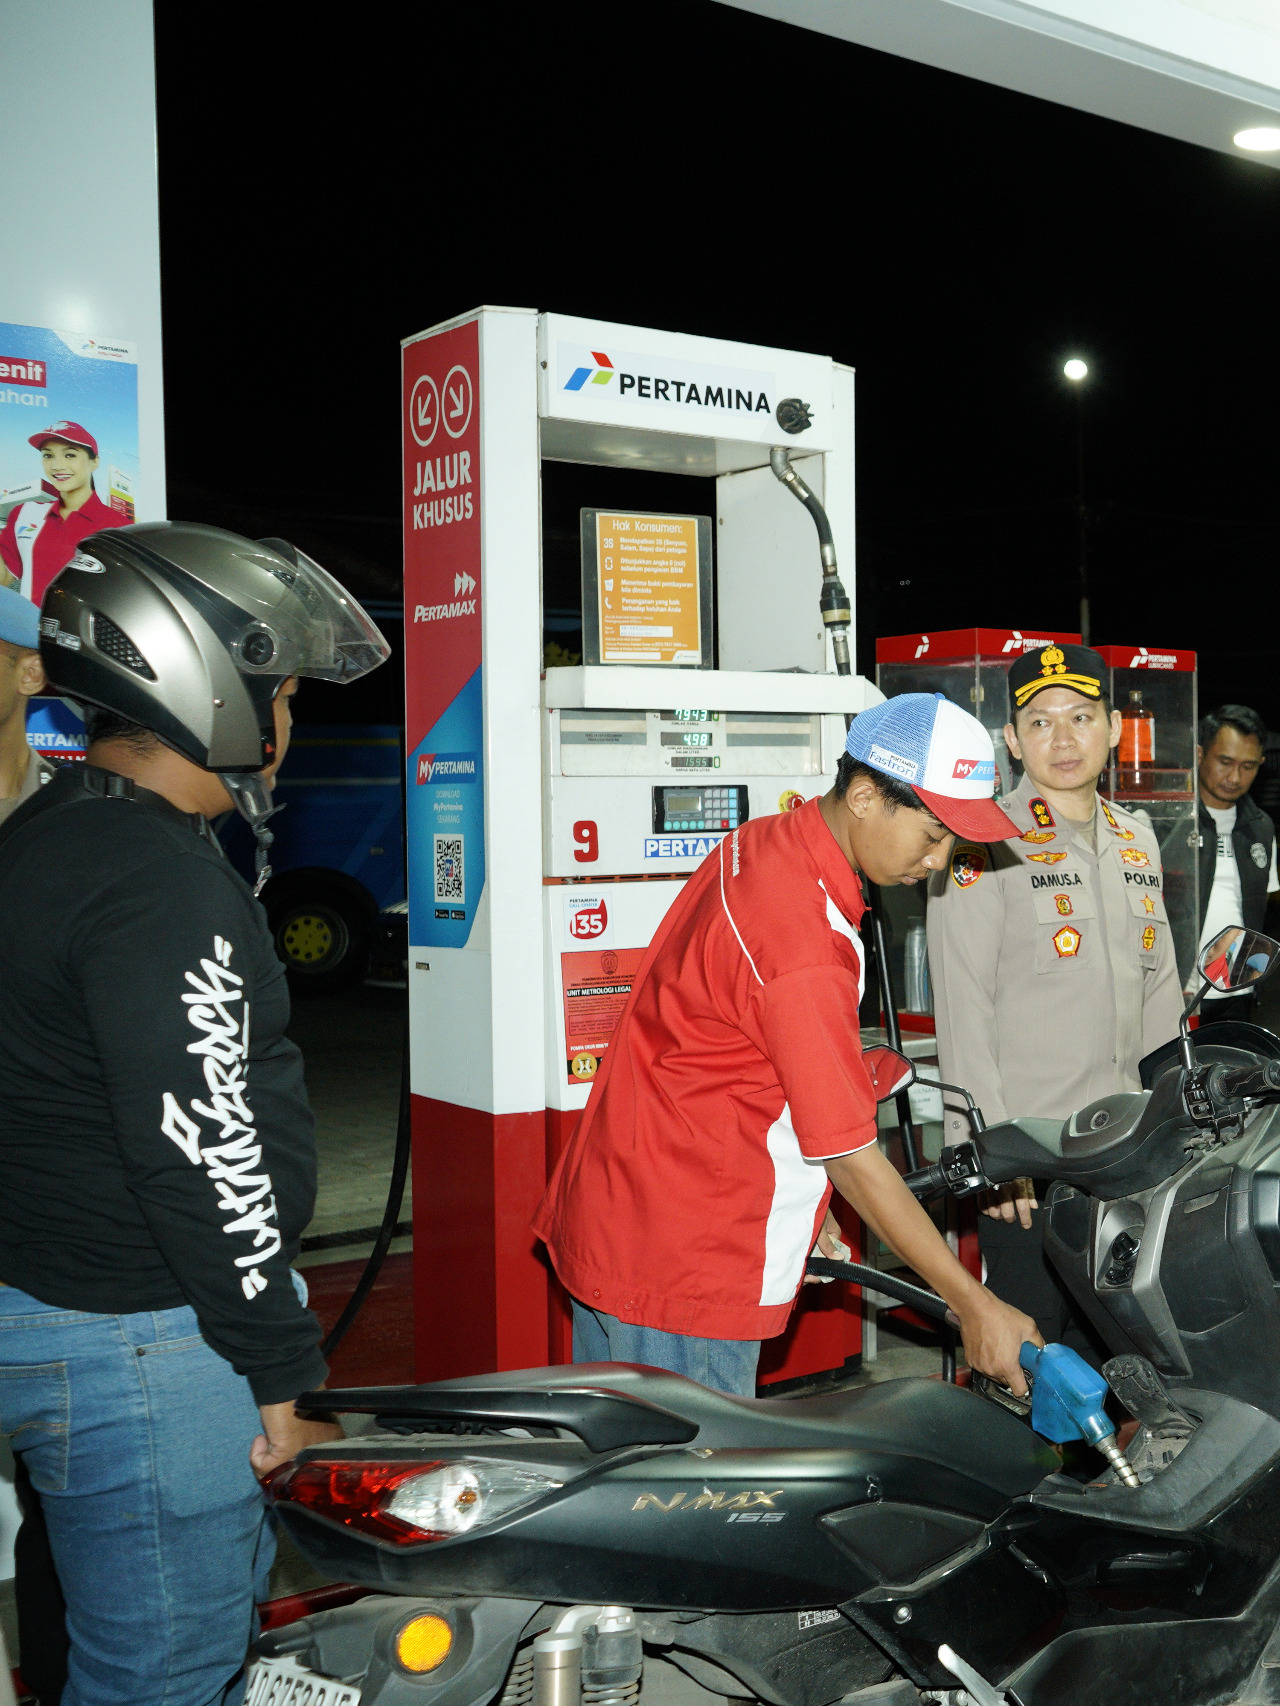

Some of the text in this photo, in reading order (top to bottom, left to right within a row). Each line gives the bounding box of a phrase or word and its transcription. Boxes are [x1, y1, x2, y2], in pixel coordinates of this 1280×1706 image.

[0, 361, 43, 381] enit
[618, 373, 771, 415] PERTAMINA
[413, 450, 472, 497] JALUR
[413, 491, 474, 530] KHUSUS
[612, 520, 683, 534] Hak Konsumen:
[603, 538, 614, 549] 3S
[413, 599, 477, 623] PERTAMAX
[890, 755, 916, 769] PERTAMINA
[573, 820, 599, 863] 9
[1030, 873, 1083, 889] DAMUS.A
[1123, 872, 1160, 888] POLRI
[571, 913, 603, 935] 135
[581, 986, 614, 996] METROLOGI
[615, 986, 631, 994] LEGAL
[631, 1489, 784, 1515] NMAX
[726, 1512, 788, 1523] 155
